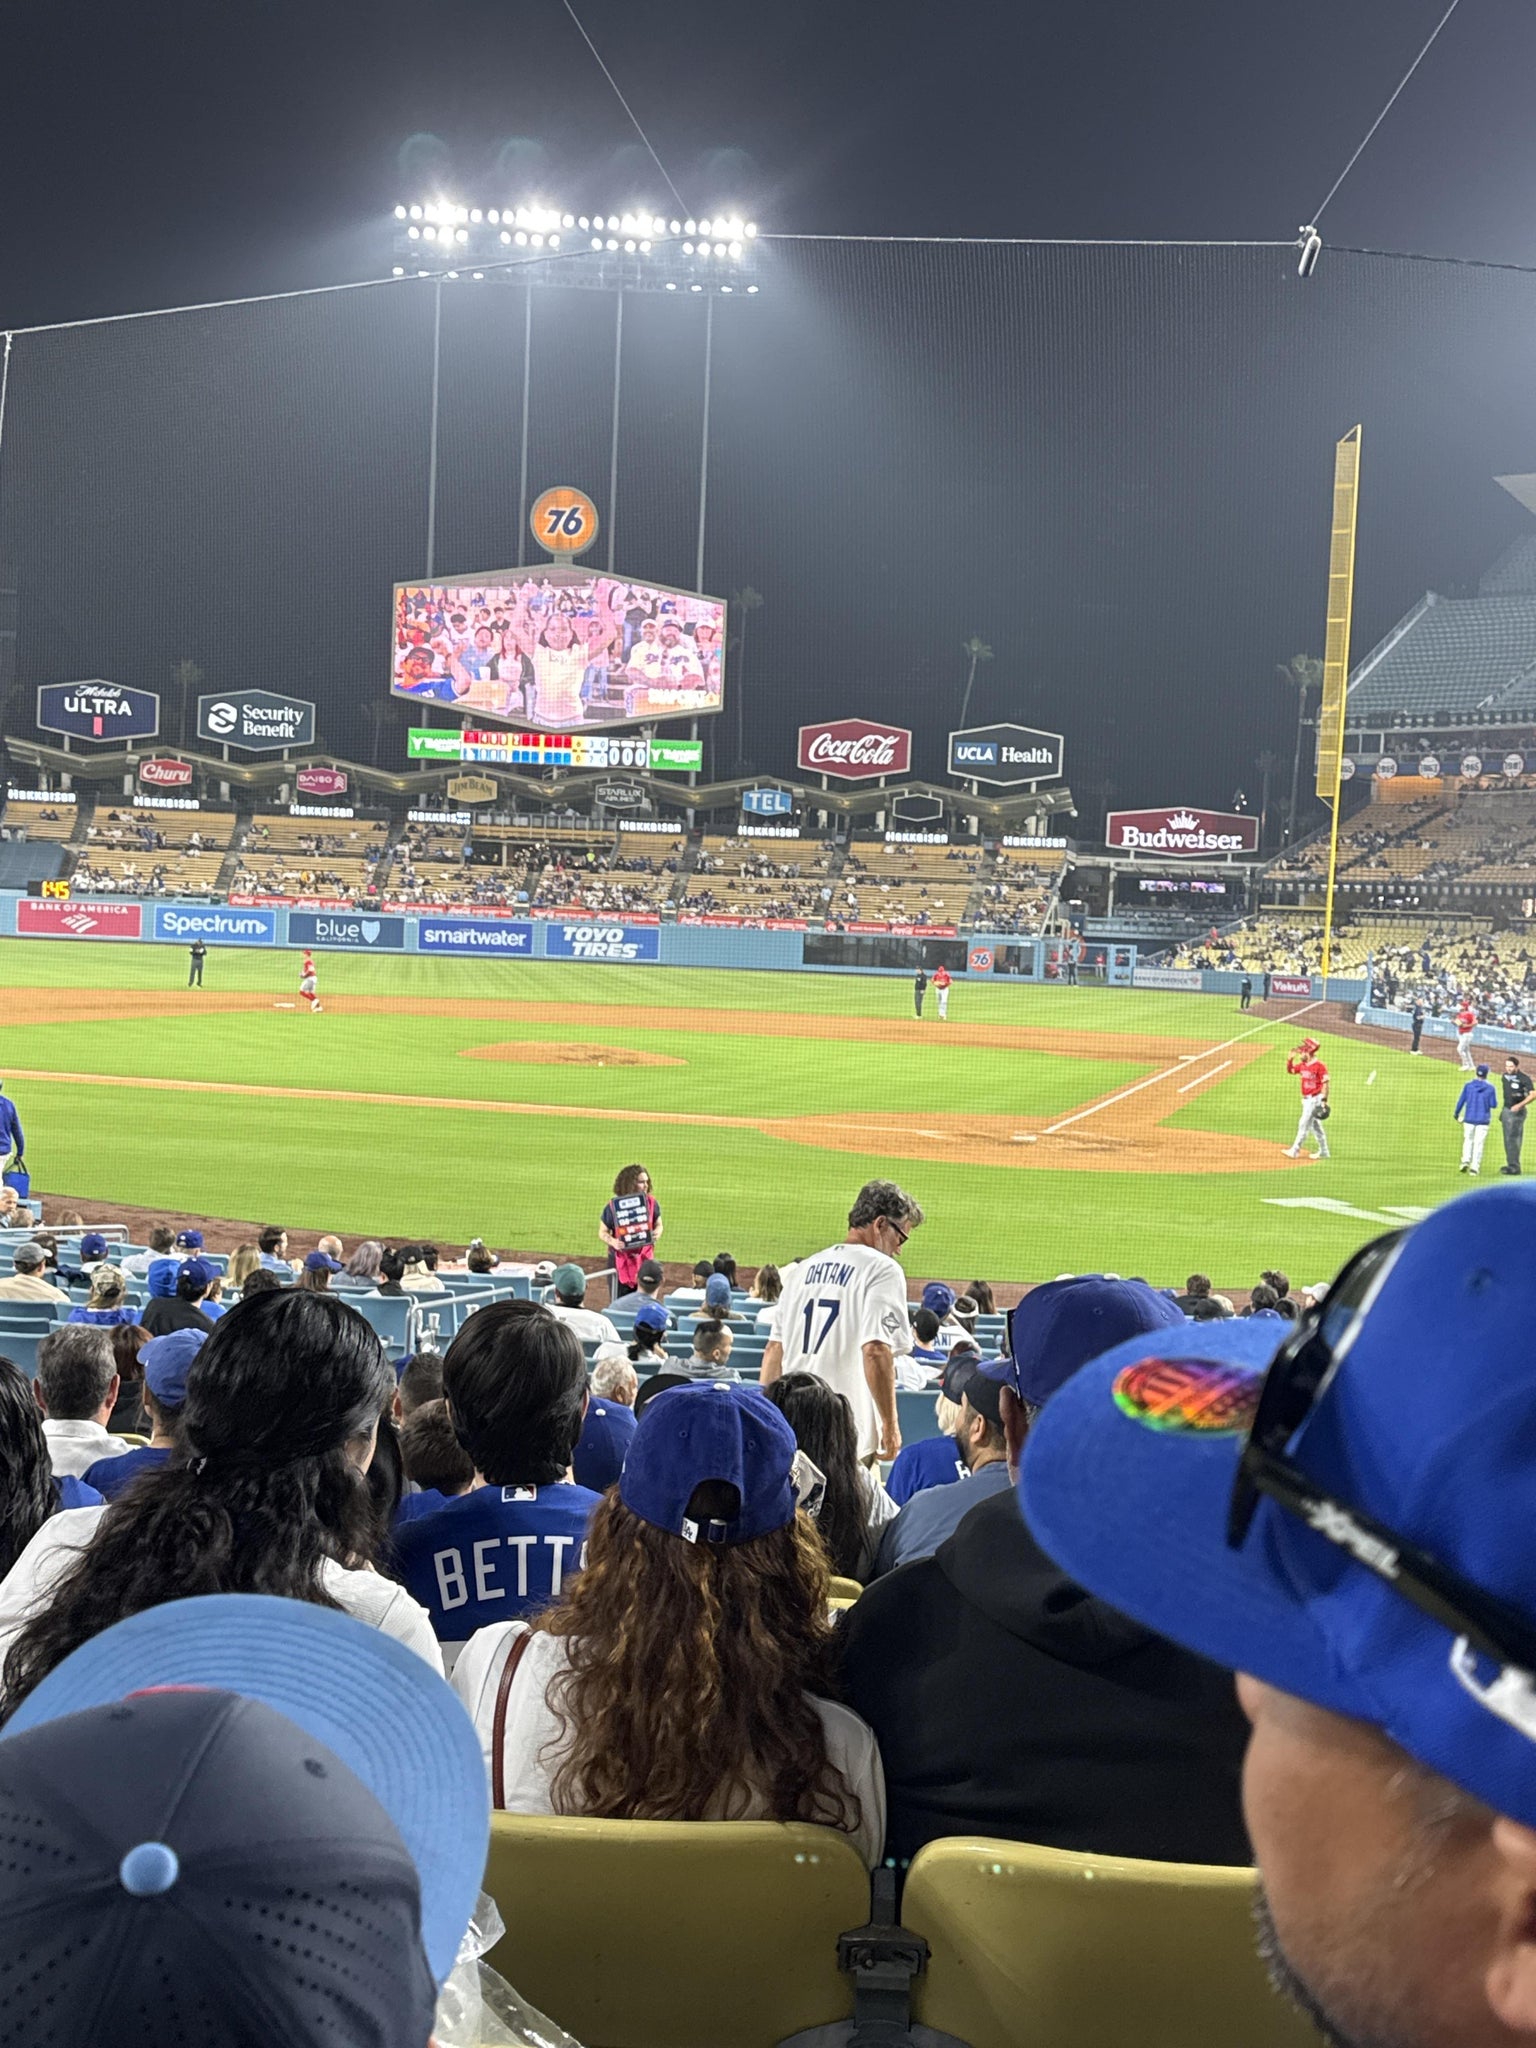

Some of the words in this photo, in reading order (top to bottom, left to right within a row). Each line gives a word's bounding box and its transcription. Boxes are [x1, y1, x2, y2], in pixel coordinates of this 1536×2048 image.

[546, 507, 583, 536] 76
[64, 697, 132, 716] ULTRA
[242, 704, 304, 725] Security
[243, 721, 295, 738] Benefit
[808, 732, 900, 766] Coca-Cola
[957, 746, 994, 761] UCLA
[1001, 746, 1053, 765] Health
[142, 763, 190, 782] Churu
[299, 773, 333, 784] DAISO
[468, 778, 494, 797] BEAM
[598, 788, 642, 798] STARLUX
[748, 792, 786, 812] TEL
[30, 902, 61, 912] BANK
[63, 903, 77, 912] OF
[79, 904, 129, 915] AMERICA
[163, 911, 263, 936] Spectrum
[316, 918, 360, 938] blue
[424, 927, 527, 947] smartwater
[563, 926, 625, 943] TOYO
[572, 942, 639, 959] TIRES
[974, 953, 989, 966] 76
[1273, 979, 1310, 994] Yakult
[804, 1262, 856, 1288] OHTANI
[801, 1298, 841, 1355] 17
[433, 1535, 588, 1612] BETT
